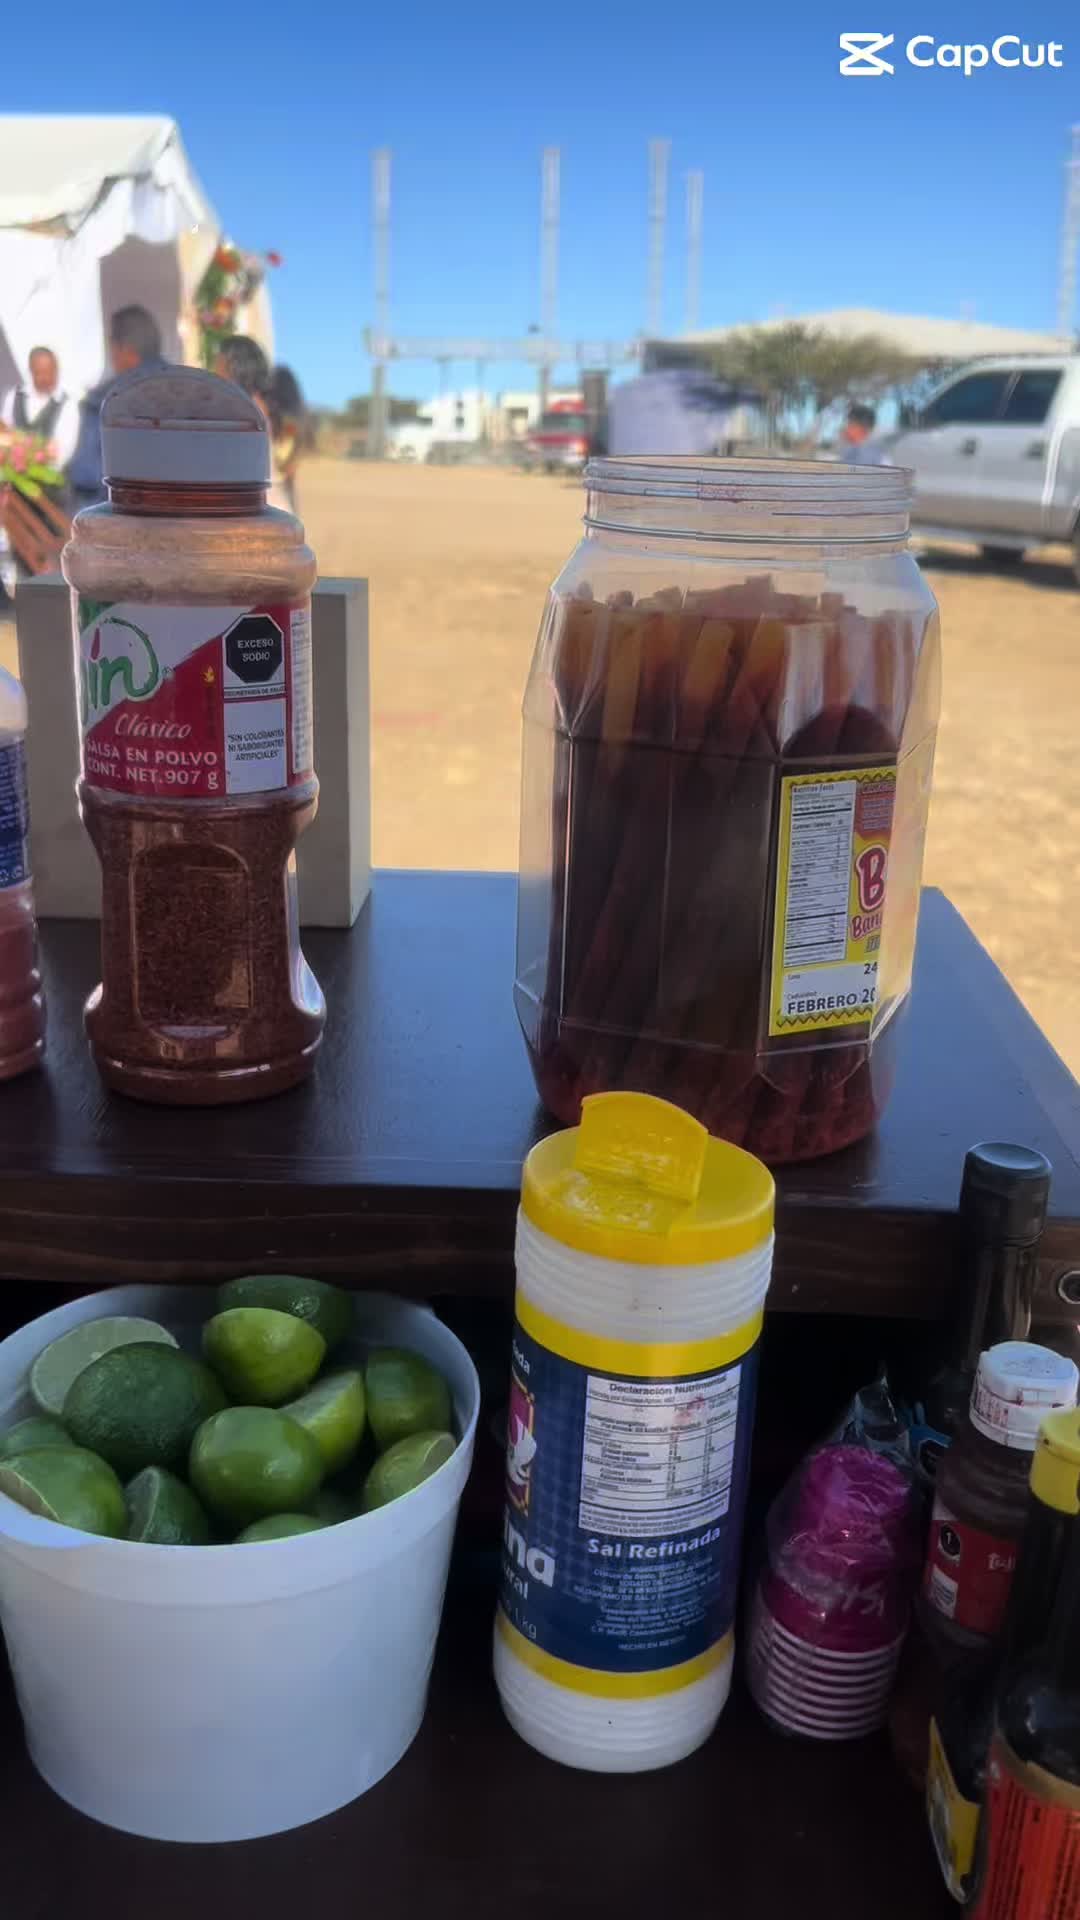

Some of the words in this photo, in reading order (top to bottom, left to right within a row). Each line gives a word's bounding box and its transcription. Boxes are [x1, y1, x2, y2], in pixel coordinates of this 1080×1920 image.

[237, 638, 274, 648] EXCESO
[242, 652, 271, 662] SODIO
[115, 713, 192, 738] Clásico
[126, 747, 148, 763] EN
[155, 751, 218, 765] POLVO
[165, 770, 200, 785] 907
[207, 773, 219, 790] g
[787, 993, 858, 1014] FEBRERO
[609, 1383, 673, 1396] Declaración
[675, 1375, 727, 1394] Nutrimental
[588, 1538, 622, 1557] Sal
[628, 1527, 721, 1559] Refinada
